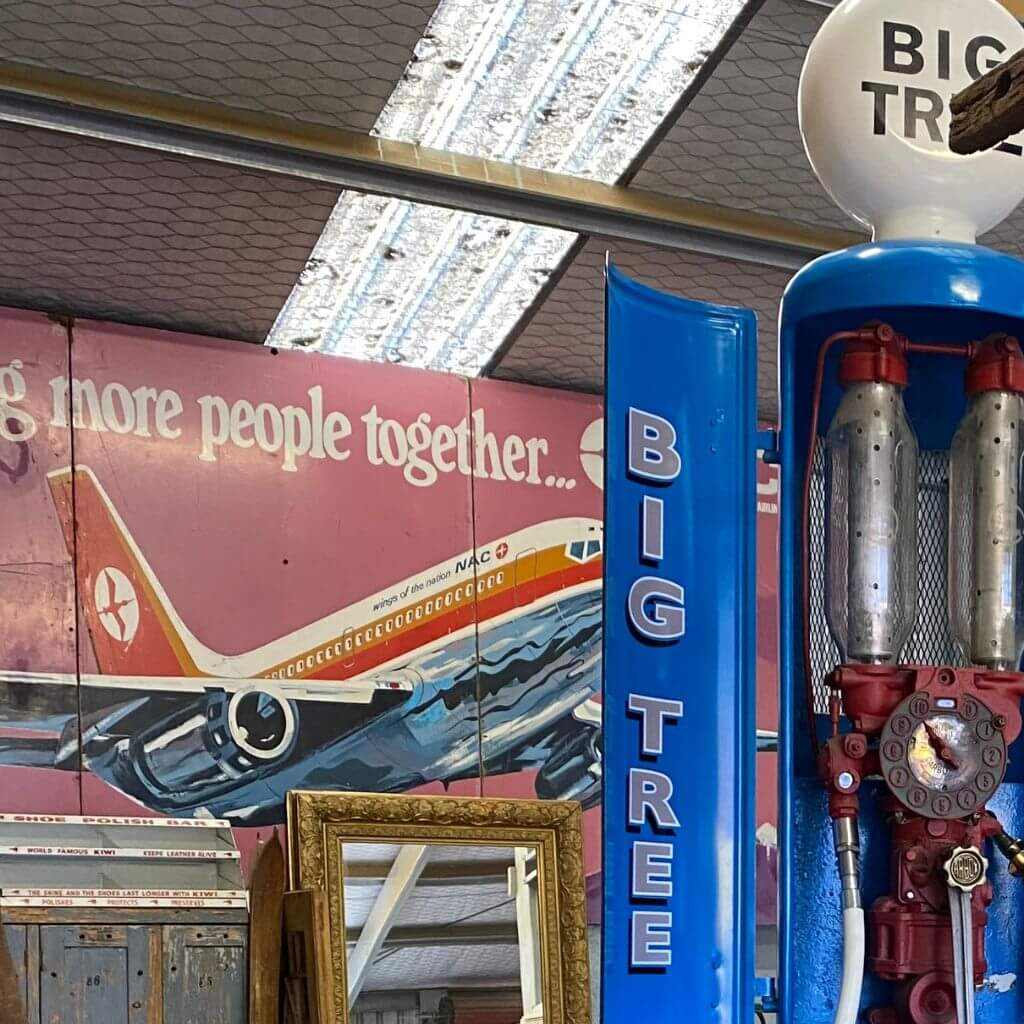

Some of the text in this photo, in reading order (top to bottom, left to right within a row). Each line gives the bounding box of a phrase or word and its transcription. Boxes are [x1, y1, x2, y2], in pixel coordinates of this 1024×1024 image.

[882, 20, 1008, 83] BIG
[861, 80, 1023, 157] TR
[48, 374, 184, 440] more
[197, 385, 352, 472] people
[361, 404, 577, 490] together...
[373, 551, 491, 611] wings of the nation NAC
[627, 406, 686, 968] BIG TREE
[13, 815, 66, 823] SHOE
[82, 817, 154, 825] POLISH
[166, 850, 196, 858] LEATHER
